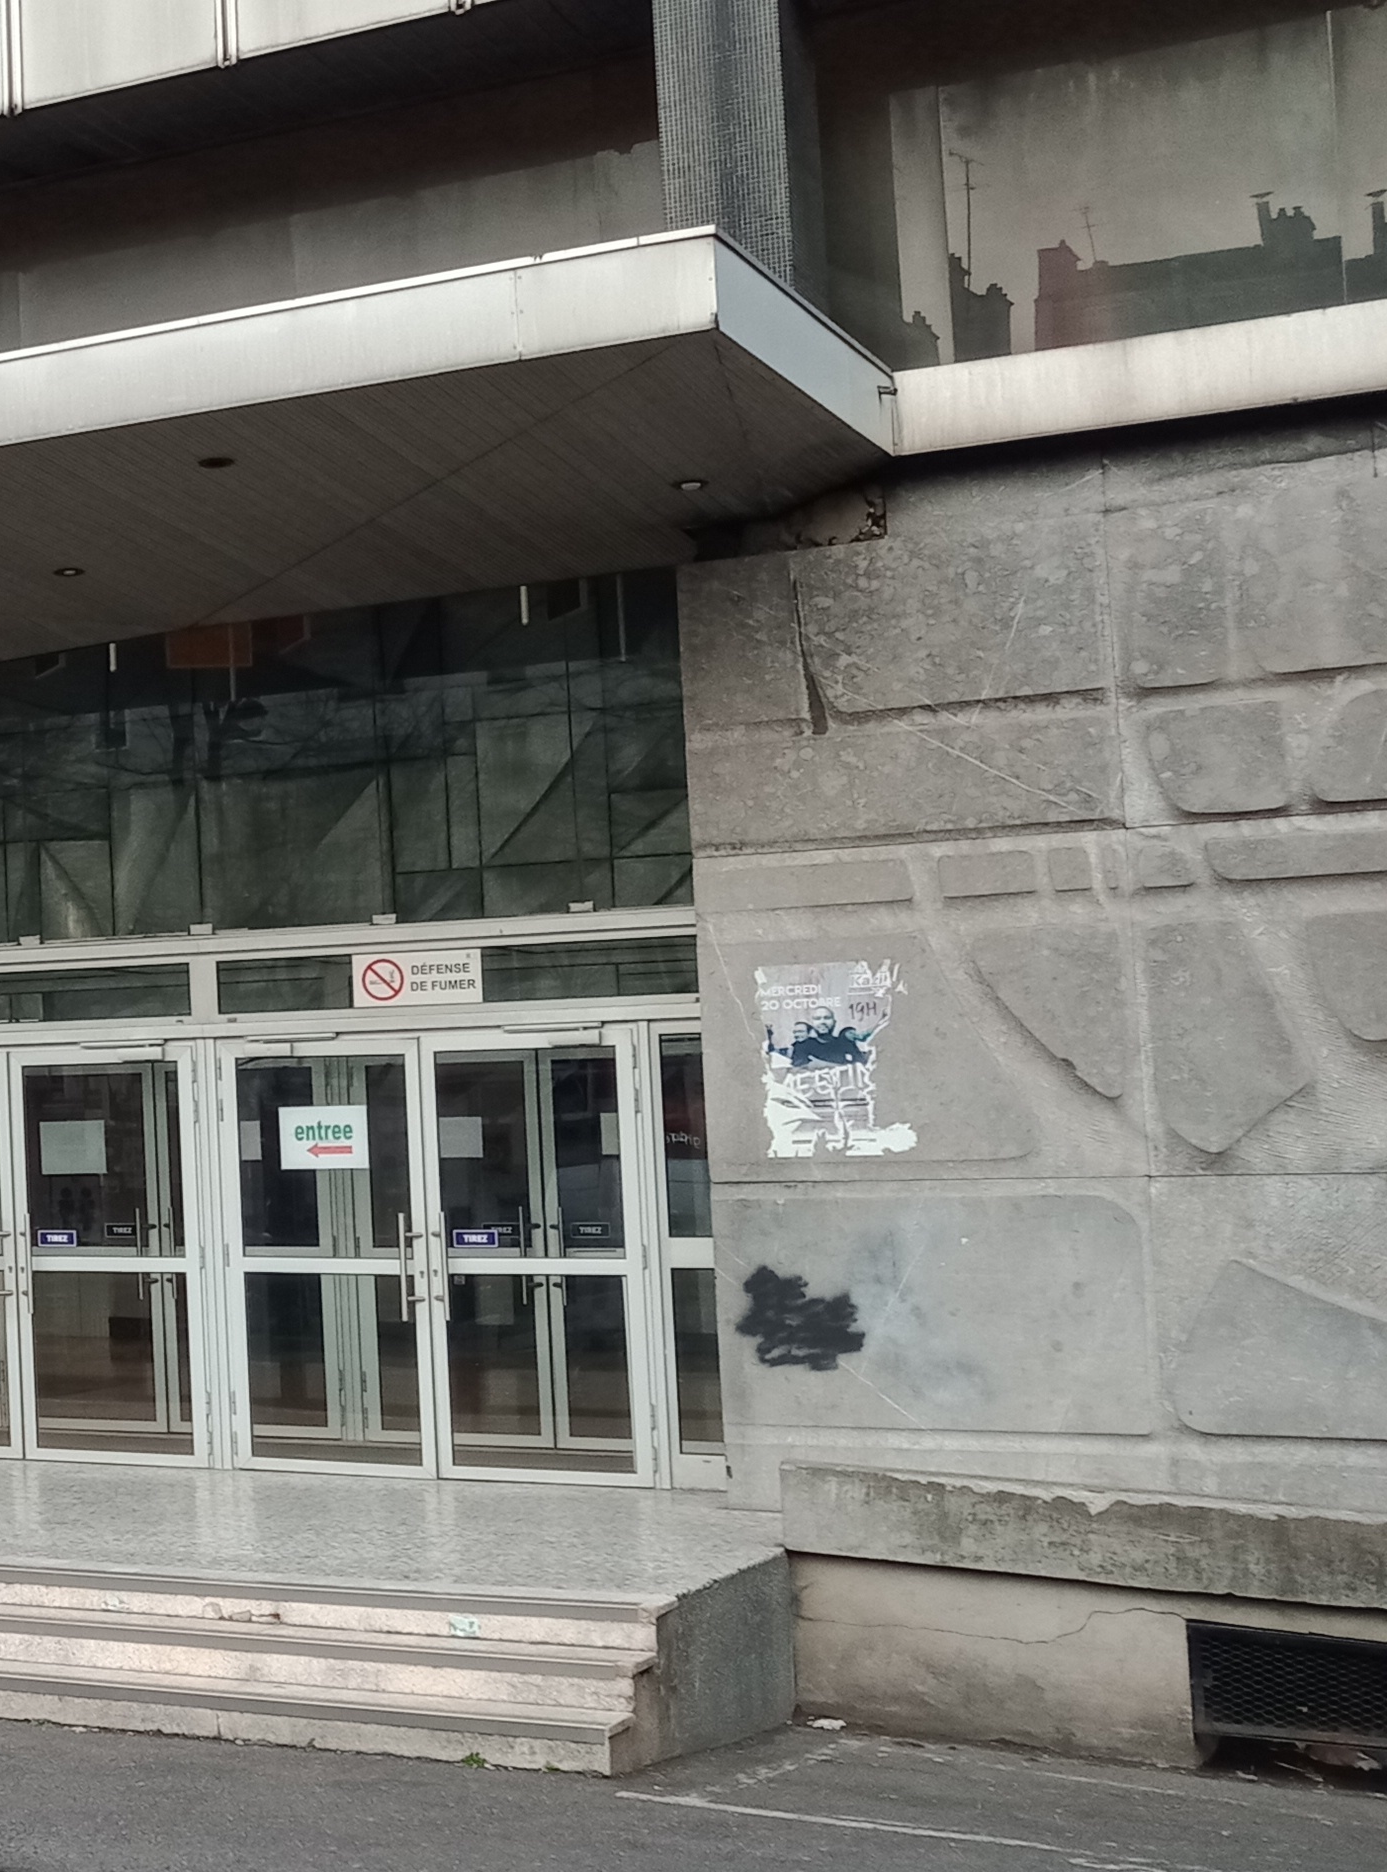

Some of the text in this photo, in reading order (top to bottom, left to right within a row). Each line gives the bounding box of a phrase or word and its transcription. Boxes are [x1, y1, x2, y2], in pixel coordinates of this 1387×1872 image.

[410, 962, 471, 976] DÉFENSE
[410, 978, 477, 992] DE FUMER
[760, 983, 822, 997] MERCREDI
[760, 999, 780, 1012] 20
[848, 1001, 878, 1022] 19H
[294, 1120, 354, 1142] entree
[579, 1226, 603, 1235] TIREZ
[46, 1234, 69, 1243] TIREZ
[463, 1234, 489, 1243] TIREZ
